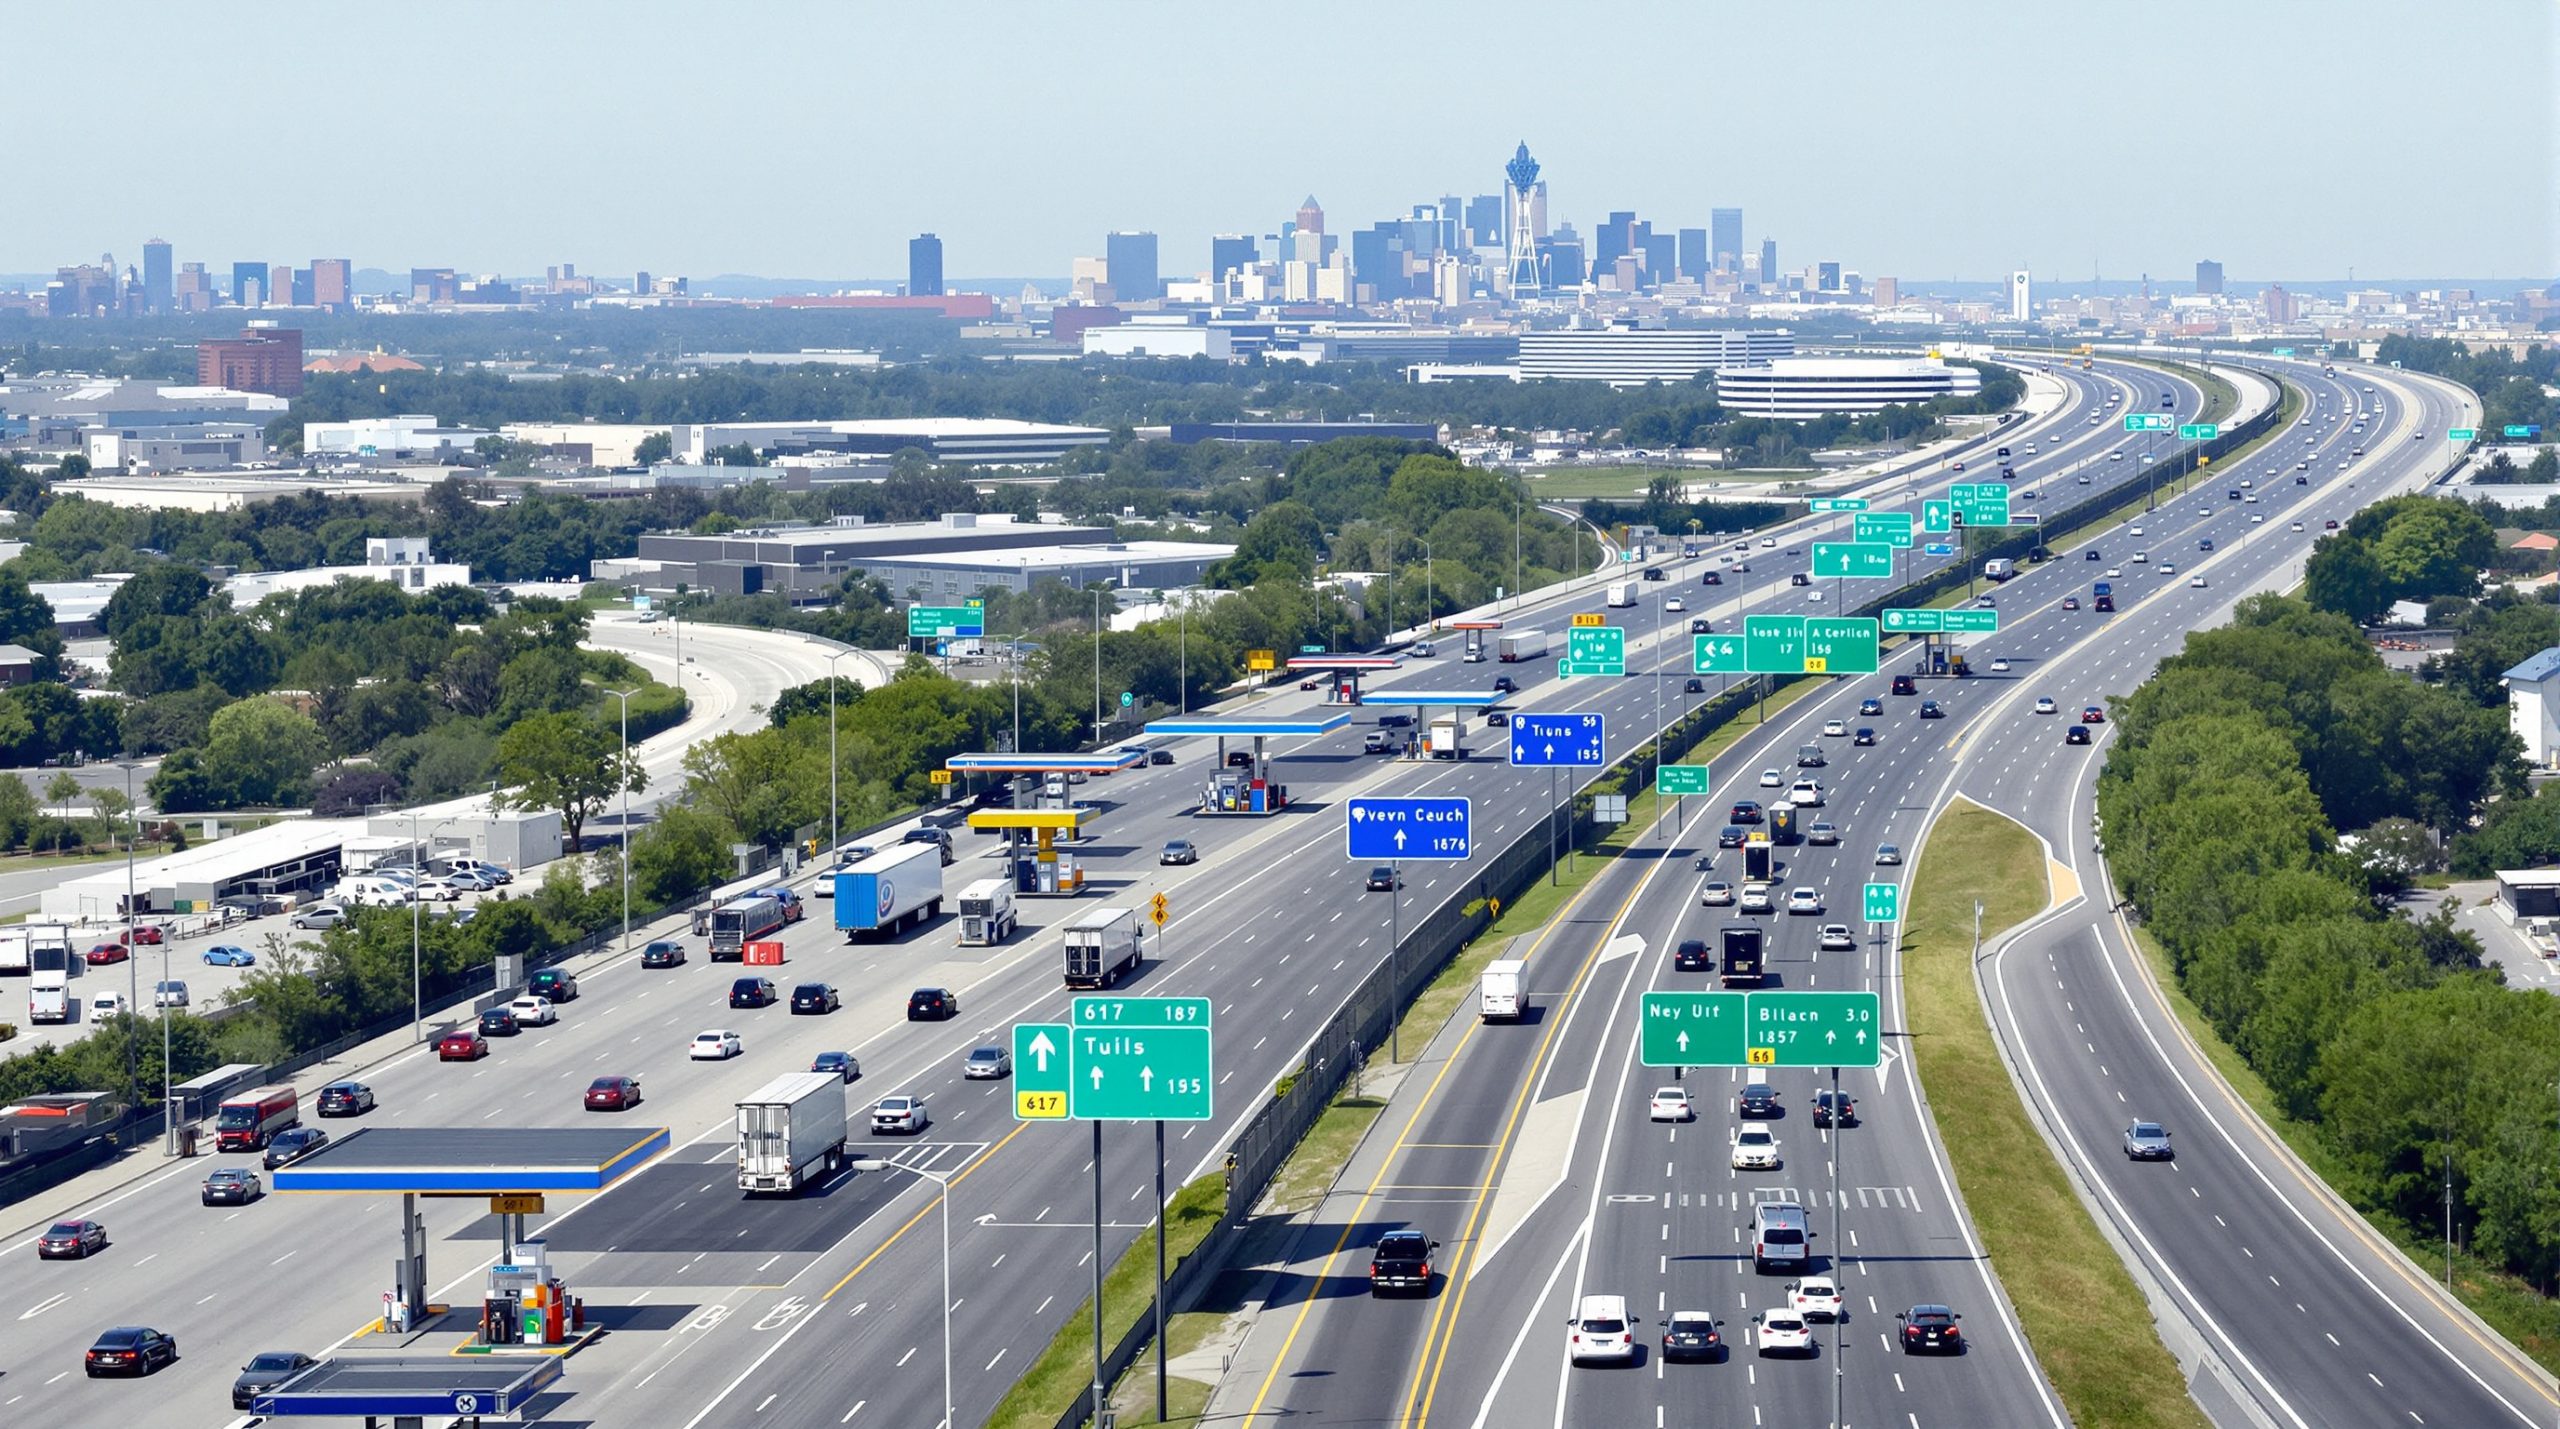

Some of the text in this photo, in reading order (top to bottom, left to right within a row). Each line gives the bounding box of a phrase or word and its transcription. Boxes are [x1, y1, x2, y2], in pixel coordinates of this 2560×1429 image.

[1084, 1003, 1124, 1021] 617
[1845, 1008, 1869, 1022] 3.0
[1084, 1037, 1145, 1055] Tuils
[1758, 1031, 1798, 1044] 1857
[1167, 1078, 1201, 1095] 195
